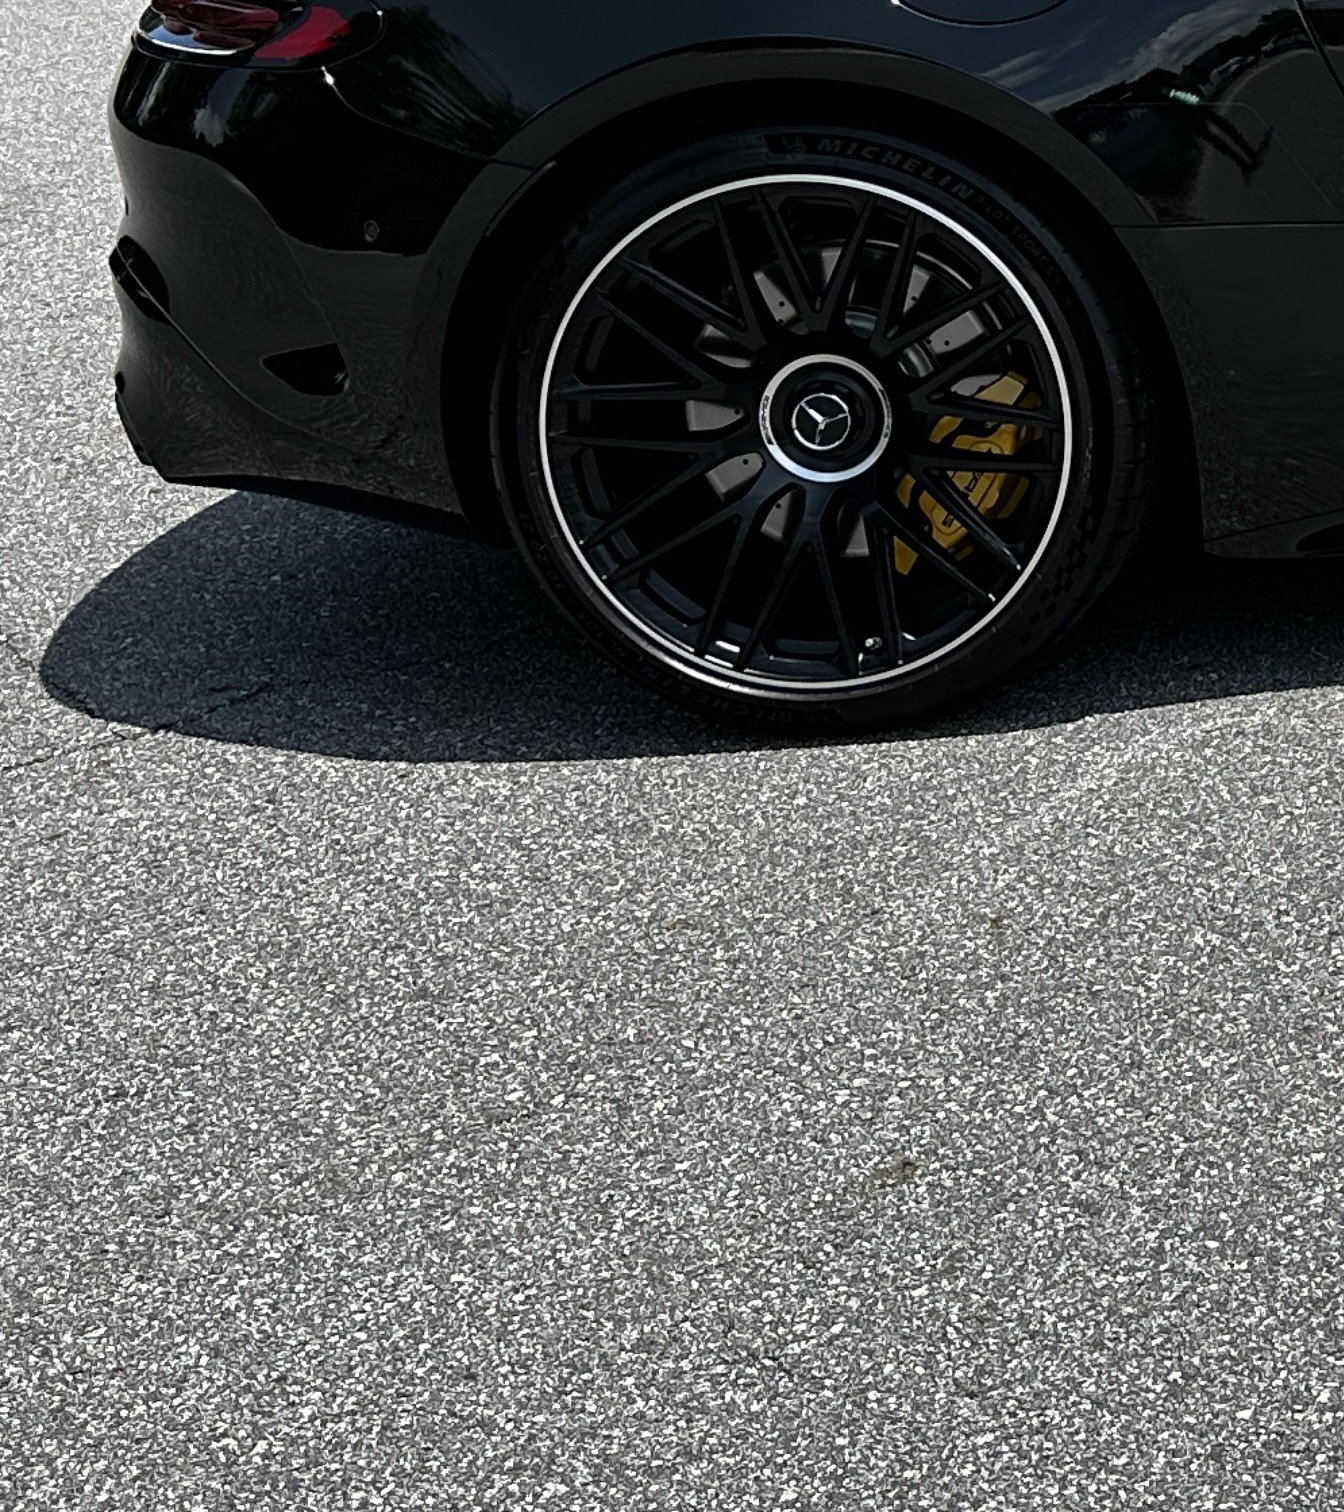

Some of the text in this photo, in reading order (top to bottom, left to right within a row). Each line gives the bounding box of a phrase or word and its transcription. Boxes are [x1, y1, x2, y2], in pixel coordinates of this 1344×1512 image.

[815, 137, 976, 202] MICHELIN
[969, 192, 1011, 228] PILOT
[1007, 222, 1049, 268] SPORT
[637, 662, 793, 722] MICHELIN
